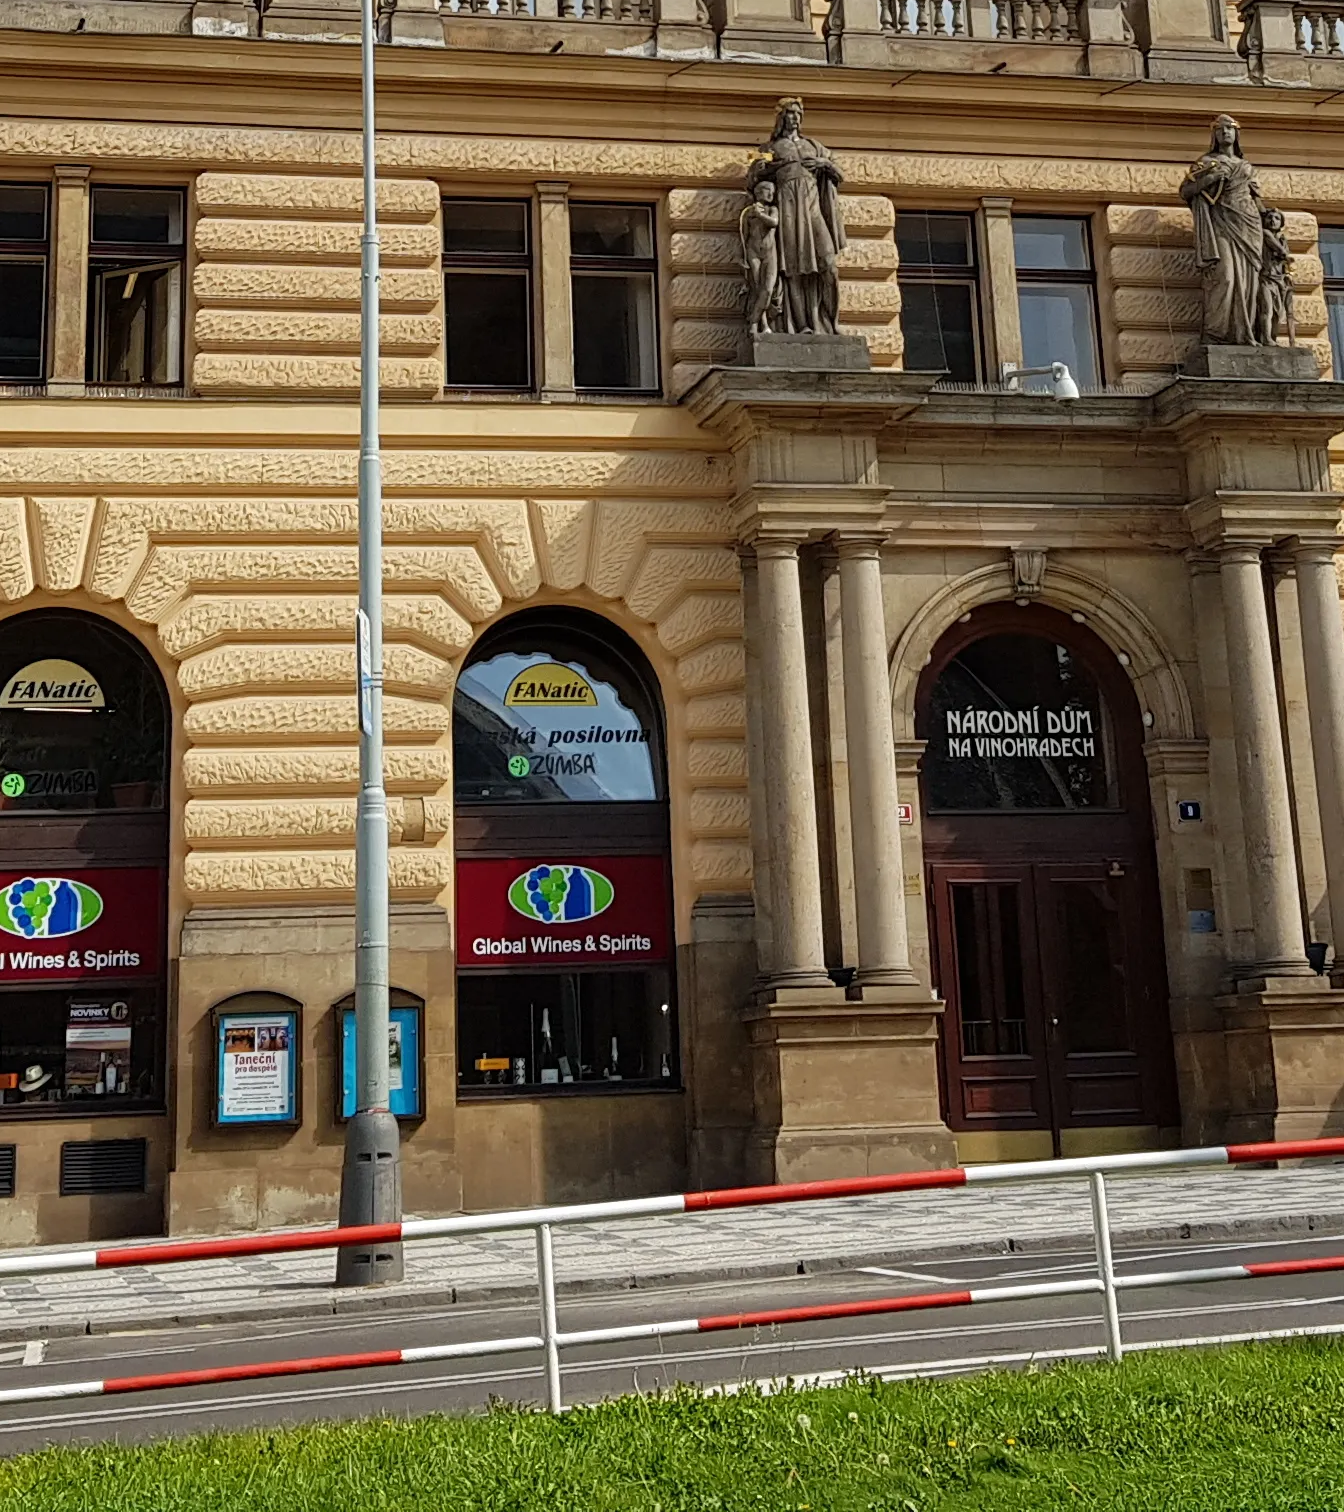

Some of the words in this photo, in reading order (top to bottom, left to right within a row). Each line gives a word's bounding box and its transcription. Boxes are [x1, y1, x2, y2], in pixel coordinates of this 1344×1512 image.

[8, 679, 98, 699] FANatic
[512, 681, 589, 699] FANatic
[946, 705, 1040, 735] NÁRODNÍ
[1046, 705, 1094, 734] DŮM
[547, 725, 652, 748] posilovna
[948, 737, 972, 758] NA
[975, 737, 1095, 758] VINOHRADECH
[25, 770, 97, 795] ZUMBA
[472, 937, 527, 955] Global
[531, 936, 582, 953] Wines
[584, 935, 597, 952] &
[599, 934, 651, 954] Spirits
[9, 951, 65, 970] Wines
[67, 951, 81, 968] &
[83, 950, 141, 971] Spirits
[233, 1052, 276, 1066] Taneční
